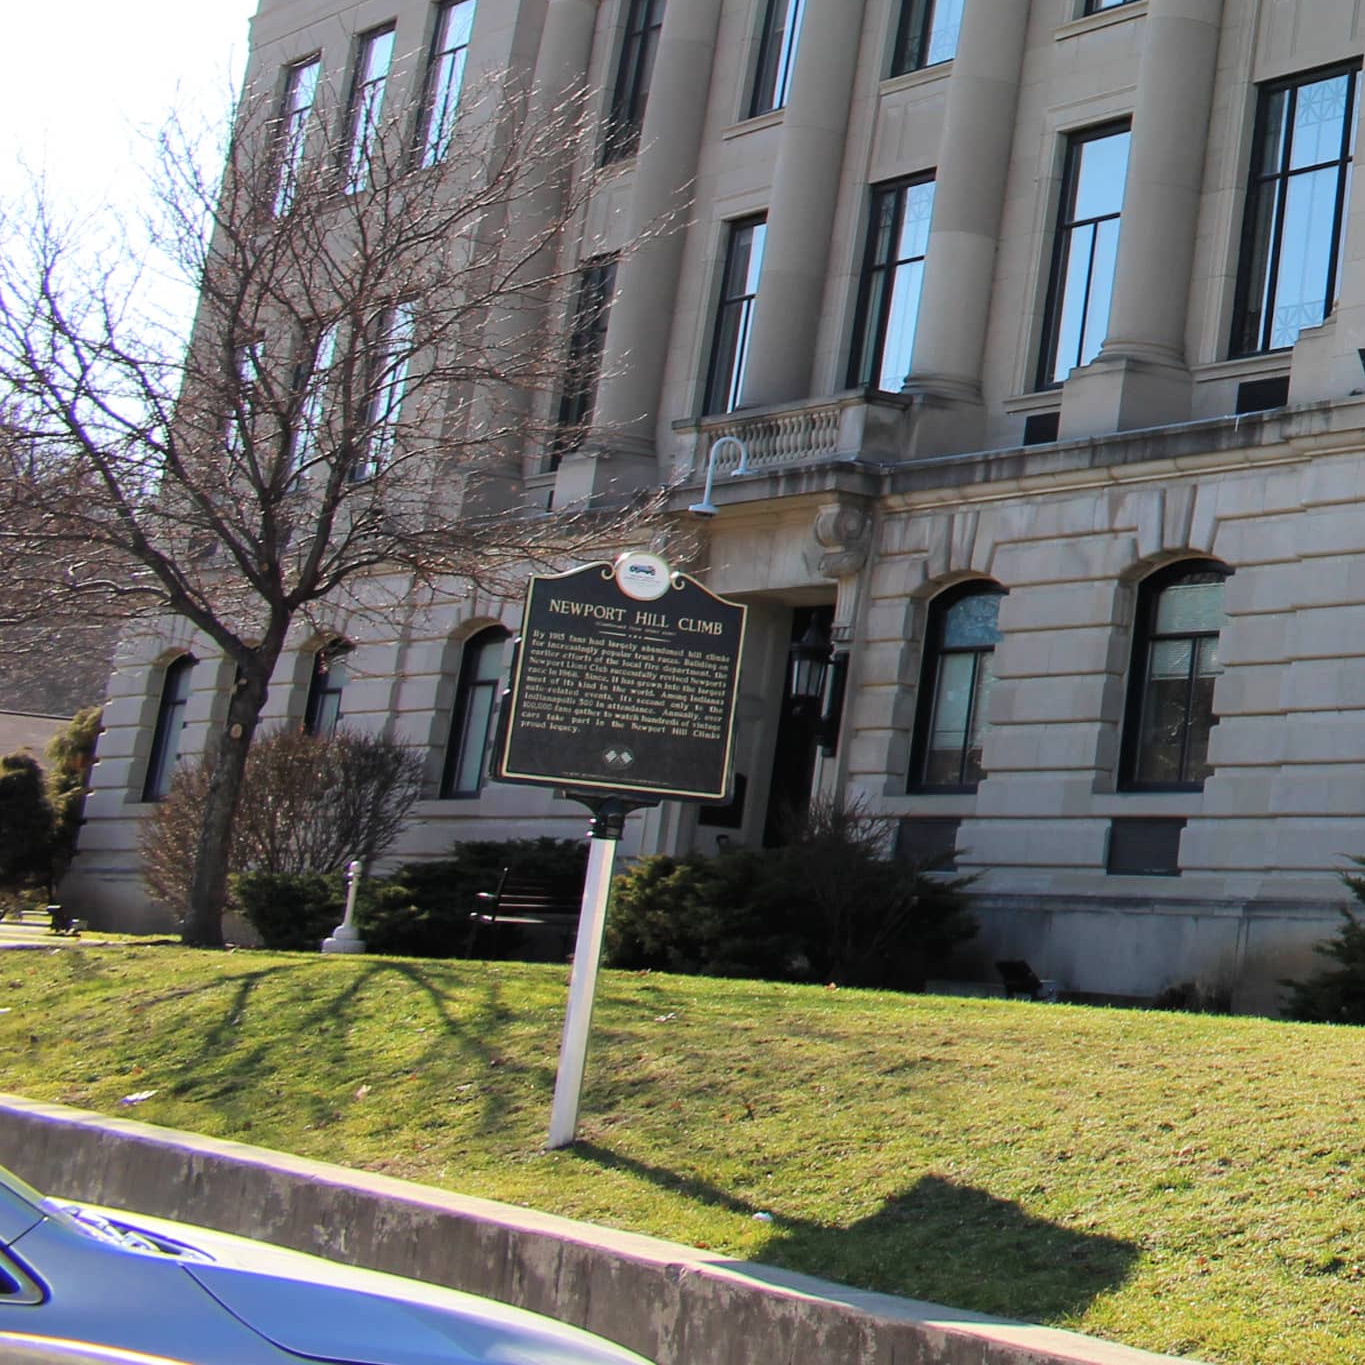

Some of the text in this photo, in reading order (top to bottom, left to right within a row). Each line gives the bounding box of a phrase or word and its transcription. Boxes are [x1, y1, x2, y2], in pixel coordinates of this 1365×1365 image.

[549, 599, 627, 623] NEWPORT
[635, 610, 670, 628] HILL
[678, 617, 723, 636] CLIMB
